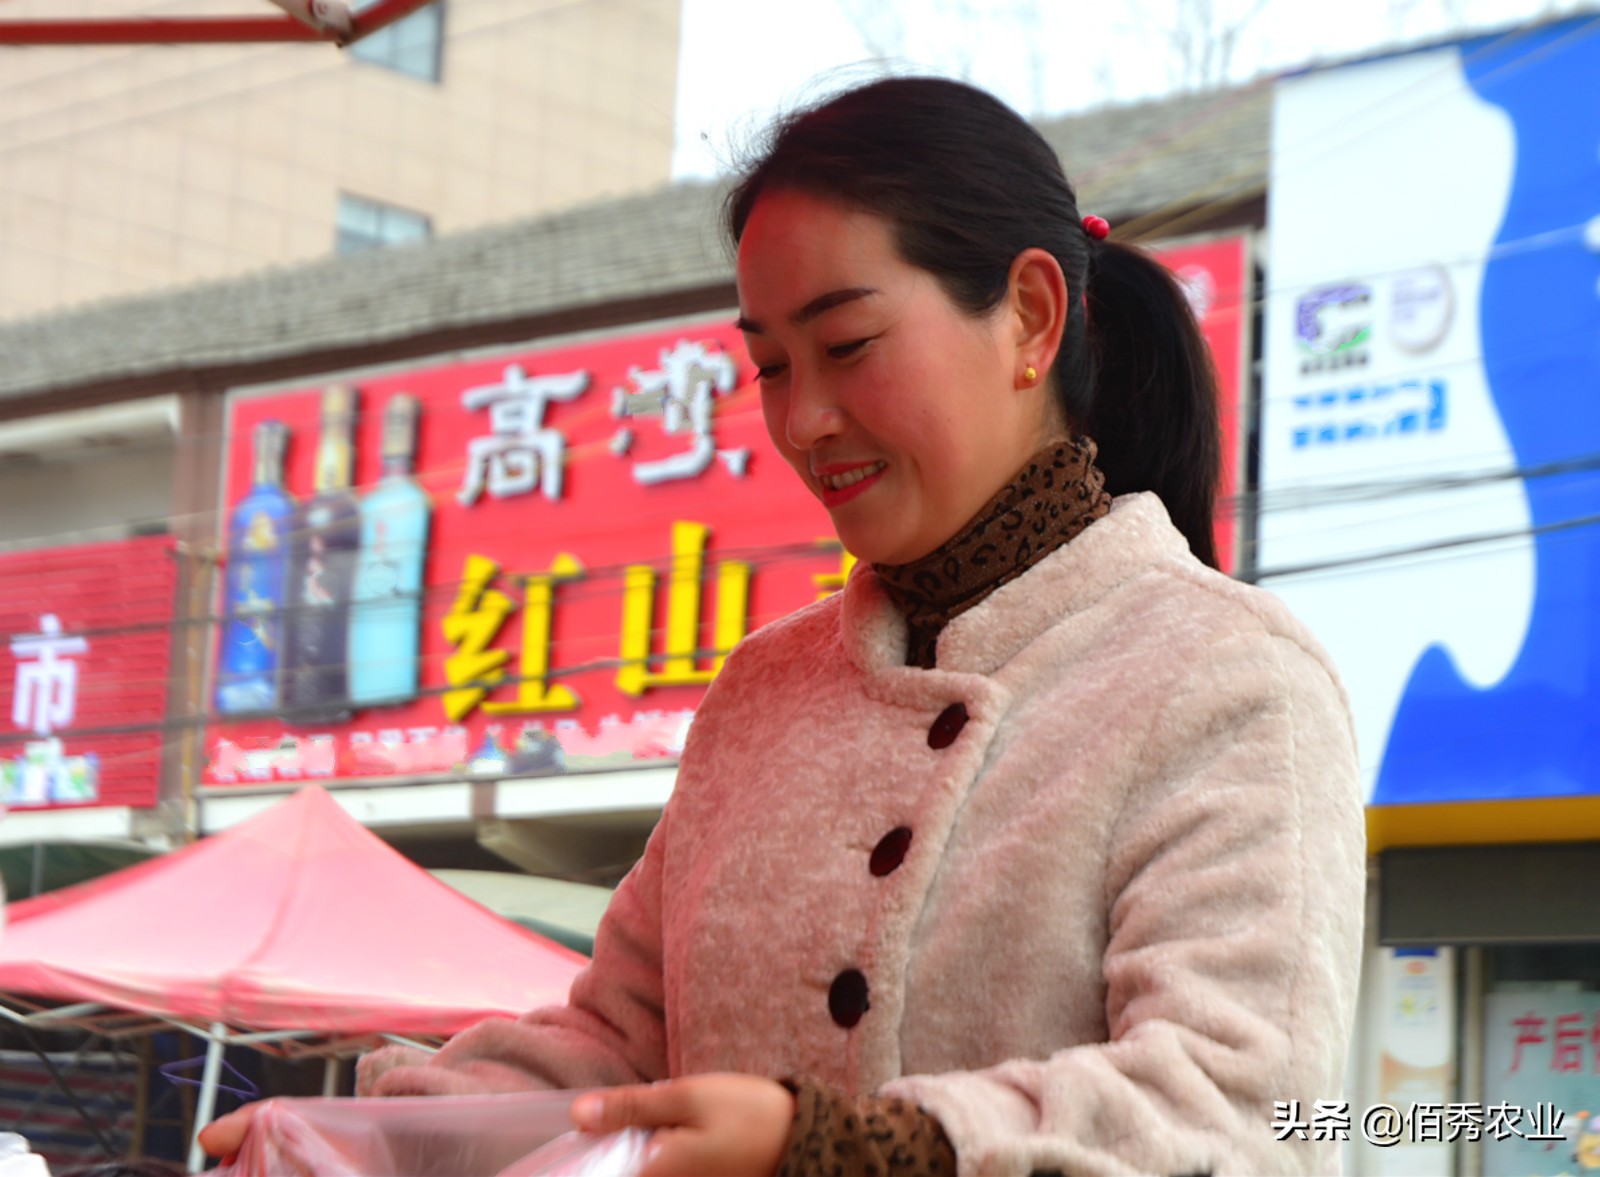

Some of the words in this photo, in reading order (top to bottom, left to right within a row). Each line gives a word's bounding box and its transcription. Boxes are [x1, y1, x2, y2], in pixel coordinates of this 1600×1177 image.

[9, 612, 89, 736] 市
[441, 519, 858, 722] 红山
[1502, 1008, 1600, 1080] 产后
